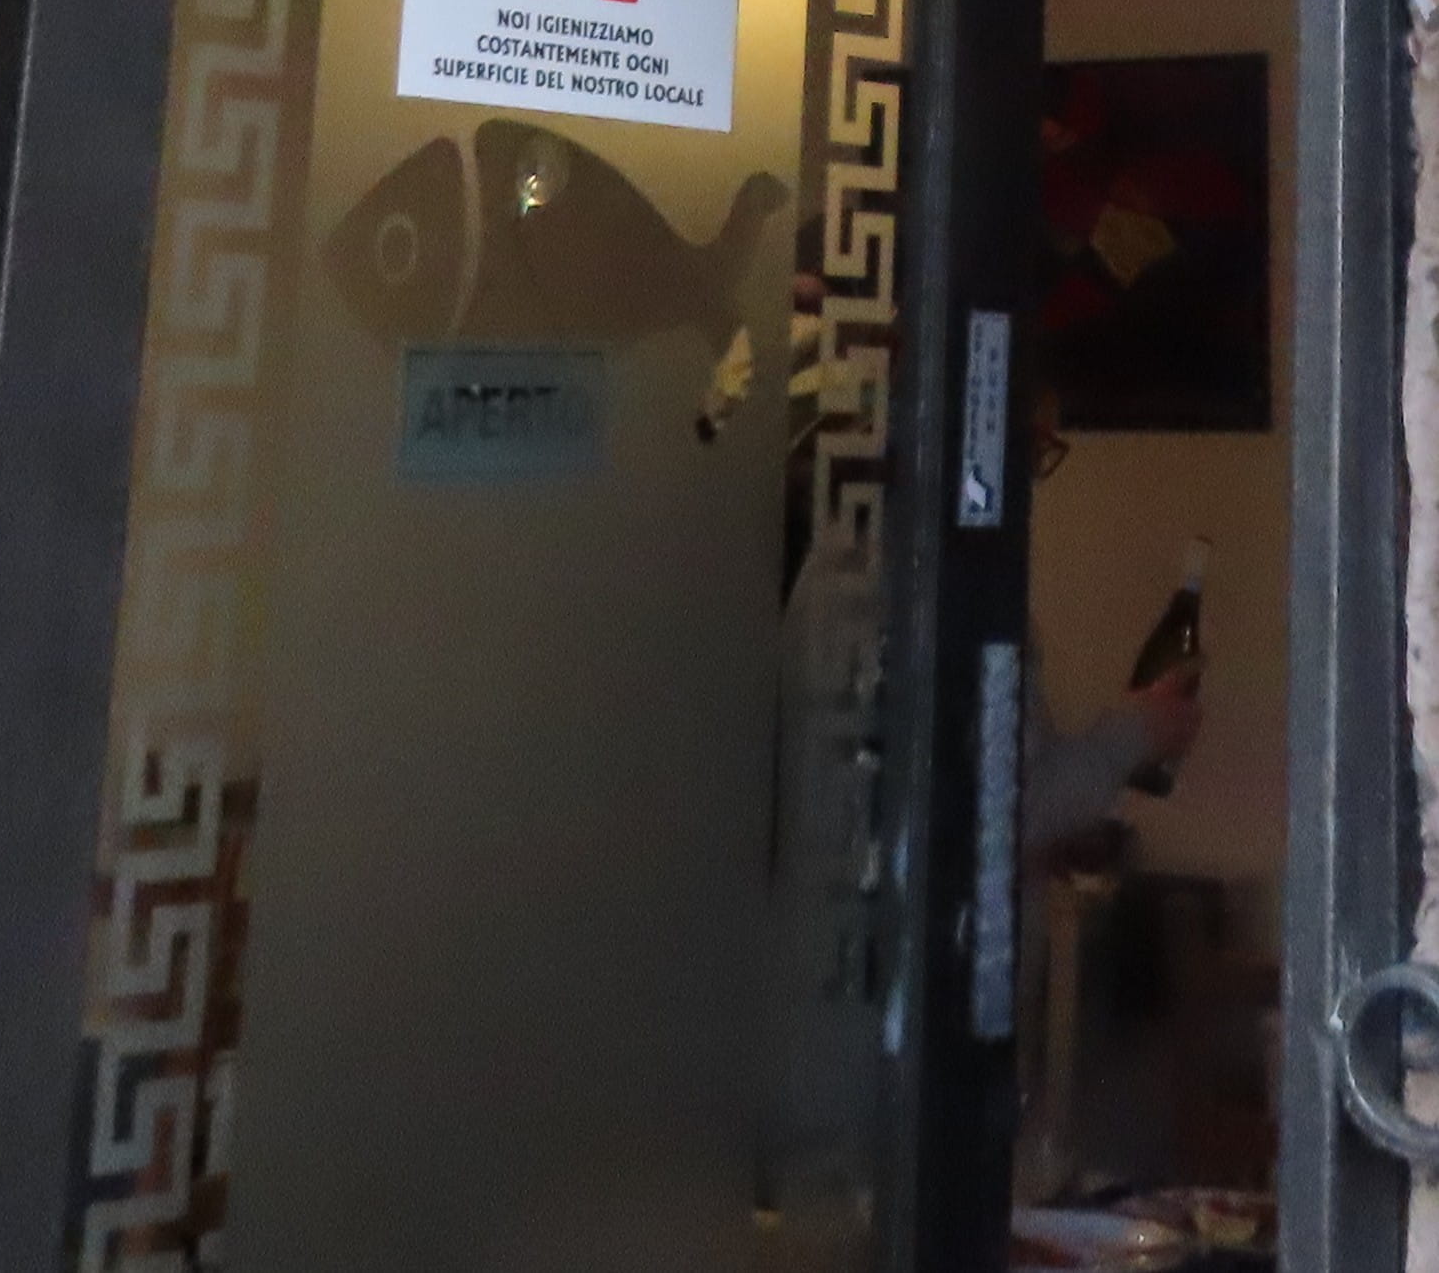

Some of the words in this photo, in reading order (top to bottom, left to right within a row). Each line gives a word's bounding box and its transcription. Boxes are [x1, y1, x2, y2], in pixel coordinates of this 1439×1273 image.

[497, 8, 531, 31] NOI
[537, 13, 654, 46] IGIENIZZIAMO
[477, 34, 621, 70] COSTANTEMENTE
[626, 53, 669, 76] OGNI
[433, 56, 529, 86] SUPERFICIE
[535, 69, 565, 90] DEL
[571, 72, 640, 99] NOSTRO
[645, 83, 704, 106] LOCALE
